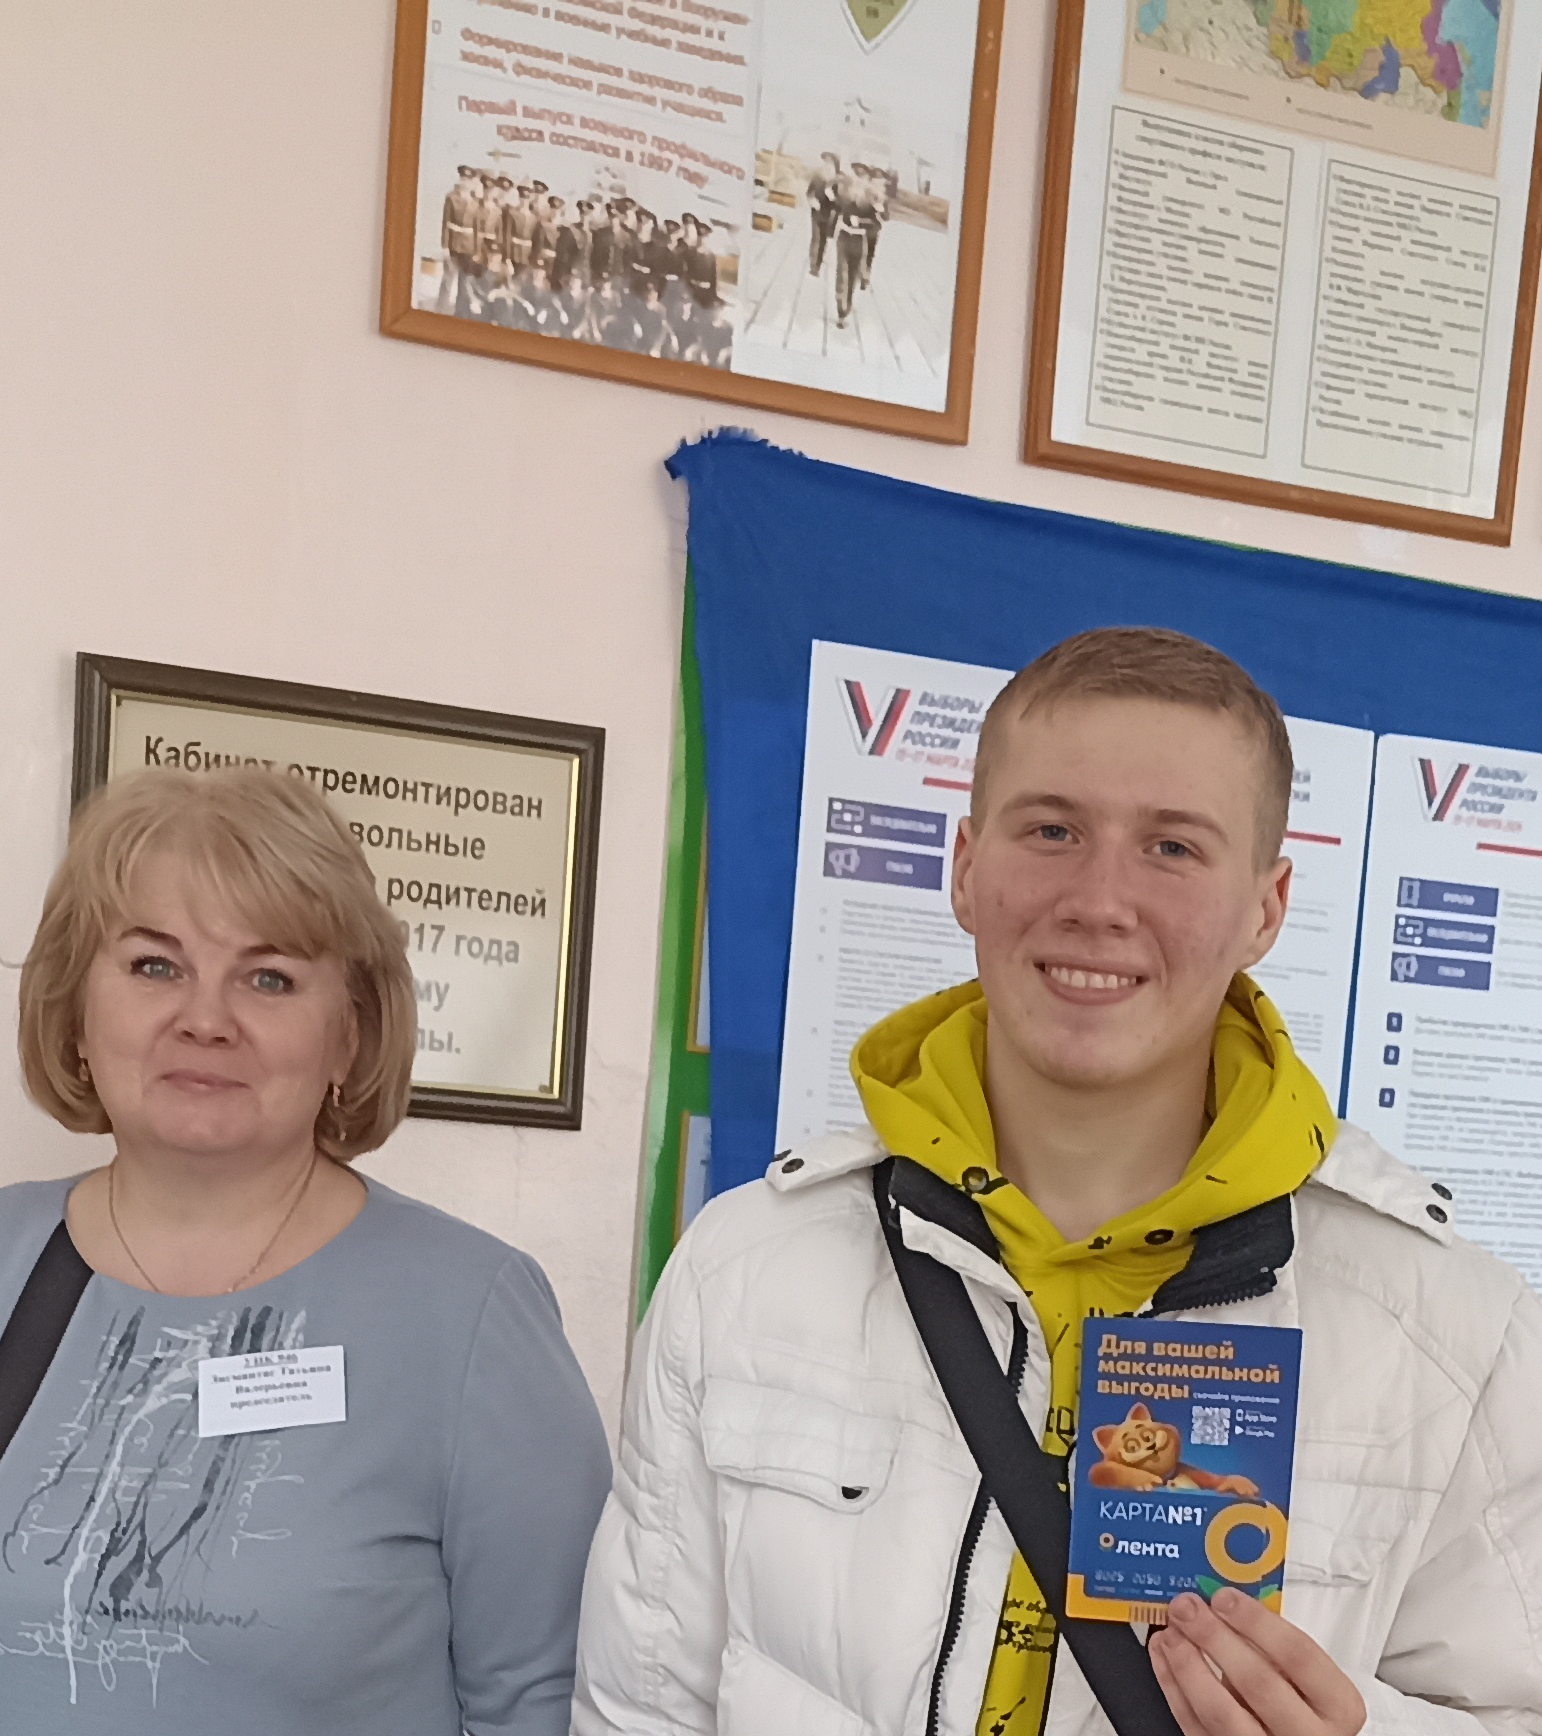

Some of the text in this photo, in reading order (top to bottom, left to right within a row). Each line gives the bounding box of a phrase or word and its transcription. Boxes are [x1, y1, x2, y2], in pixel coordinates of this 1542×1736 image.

[287, 762, 543, 818] отремонтирован
[387, 878, 546, 918] родителей
[454, 934, 520, 967] года
[1098, 1335, 1234, 1359] Для вашей
[1098, 1360, 1280, 1384] максимальной
[1097, 1380, 1189, 1399] выгоды
[1116, 1539, 1180, 1559] лента
